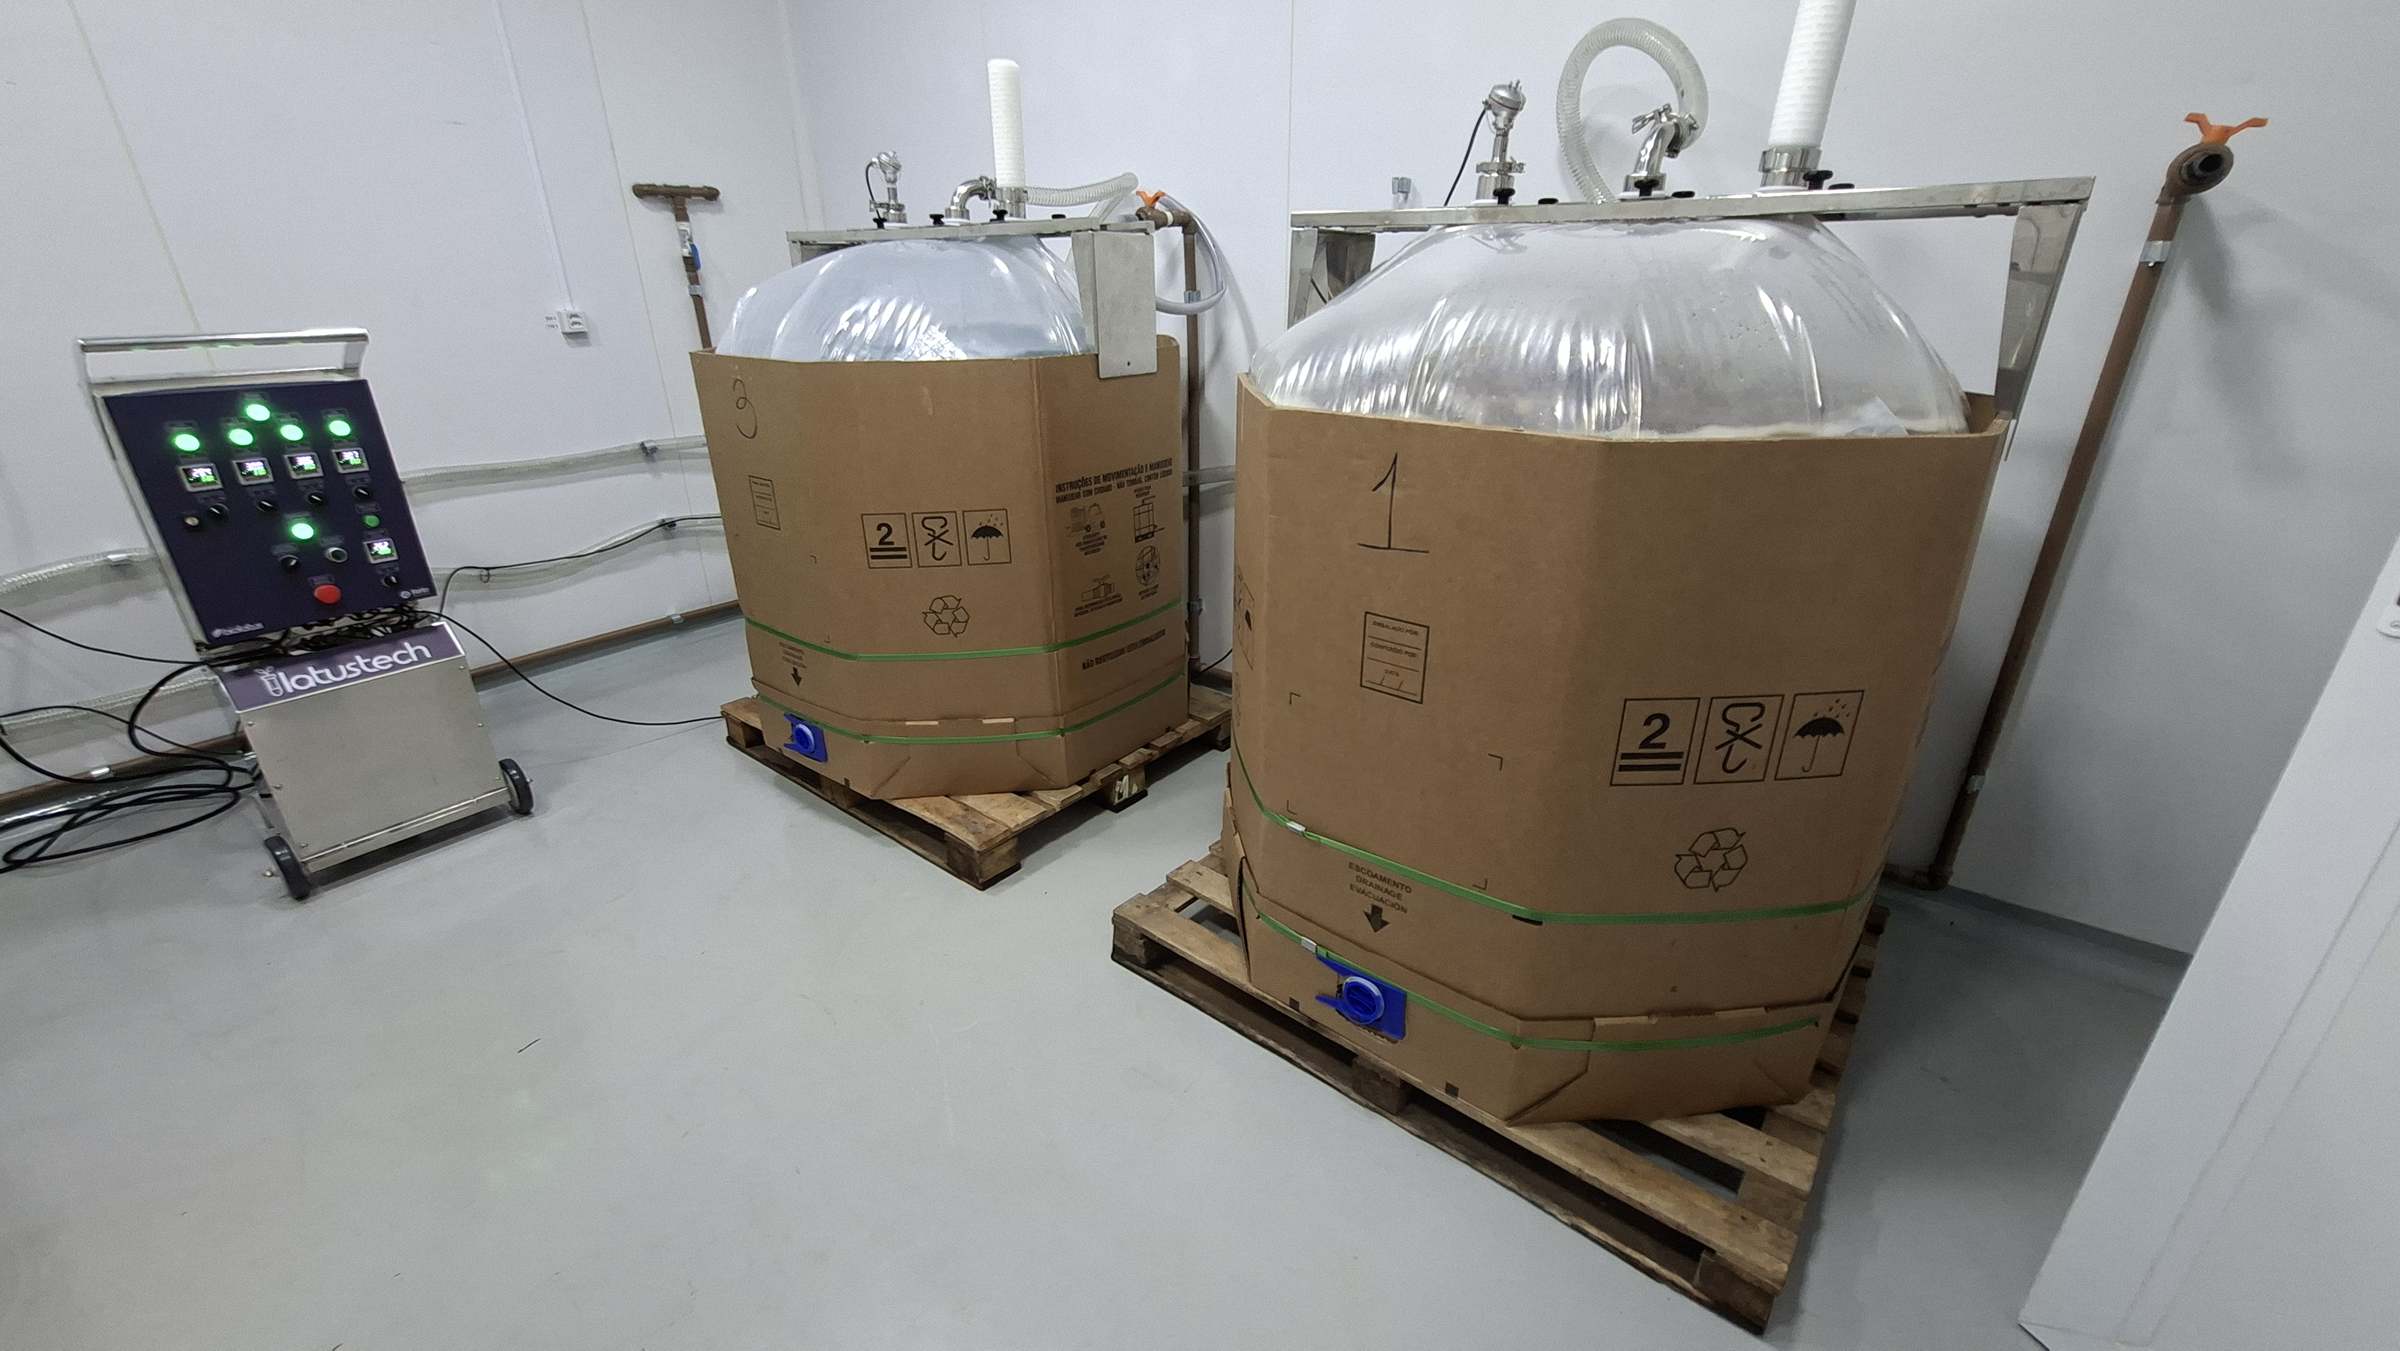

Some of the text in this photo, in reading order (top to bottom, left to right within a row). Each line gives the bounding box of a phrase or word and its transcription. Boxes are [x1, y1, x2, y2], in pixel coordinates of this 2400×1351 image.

[1094, 475, 1101, 485] DE
[1356, 452, 1430, 554] 1
[876, 522, 895, 545] 2
[277, 641, 433, 693] latustech
[1641, 711, 1671, 750] 2
[1348, 862, 1412, 894] ESCOAMENTO
[1355, 875, 1403, 901] DRAINAGE
